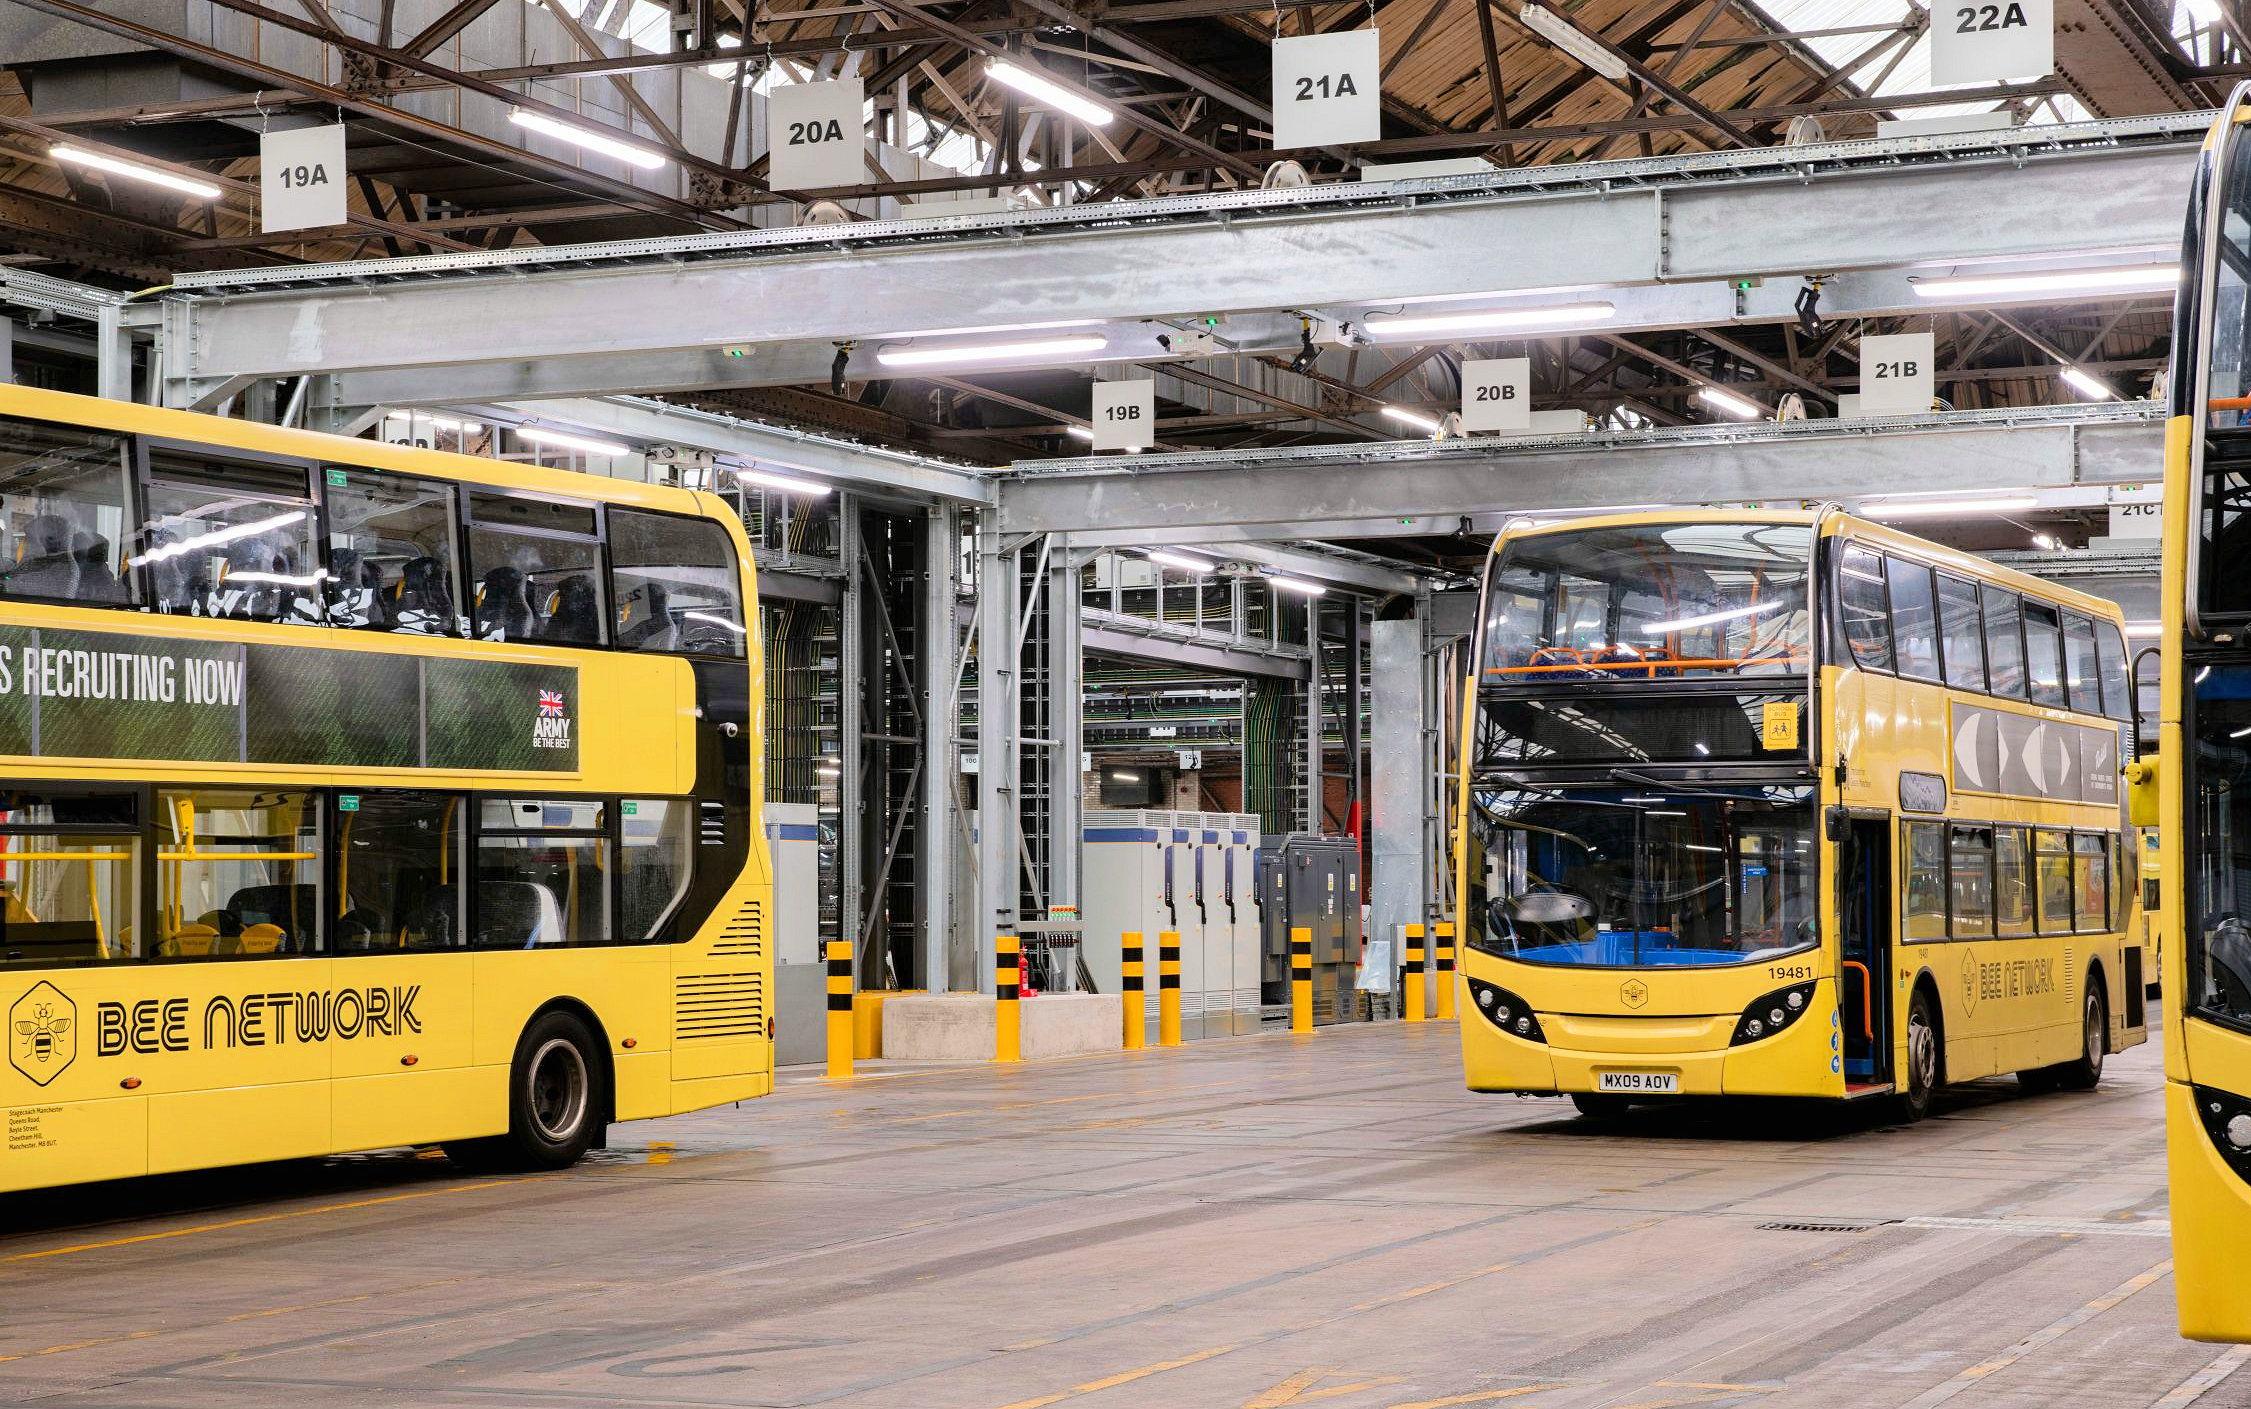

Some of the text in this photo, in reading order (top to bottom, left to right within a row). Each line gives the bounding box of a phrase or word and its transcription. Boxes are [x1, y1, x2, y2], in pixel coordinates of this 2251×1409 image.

[1956, 2, 2028, 34] 22A
[1295, 74, 1358, 101] 21A
[788, 119, 844, 146] 20A
[280, 164, 329, 189] 19A
[1875, 361, 1918, 379] 21B
[1476, 384, 1516, 402] 20B
[1105, 406, 1141, 421] 19B
[2122, 505, 2155, 516] 21C
[23, 647, 175, 703] RECRUITING
[185, 657, 243, 706] NOW
[533, 716, 570, 738] ARMY
[533, 738, 570, 749] BE THE BEST
[1768, 966, 1812, 979] 19481
[1980, 957, 2055, 1000] BEE NETWORK
[97, 985, 422, 1057] BEE NETWORK
[1605, 1074, 1671, 1089] MX09 AOV
[9, 1108, 36, 1117] Stagecoach
[9, 1118, 27, 1126] Queens
